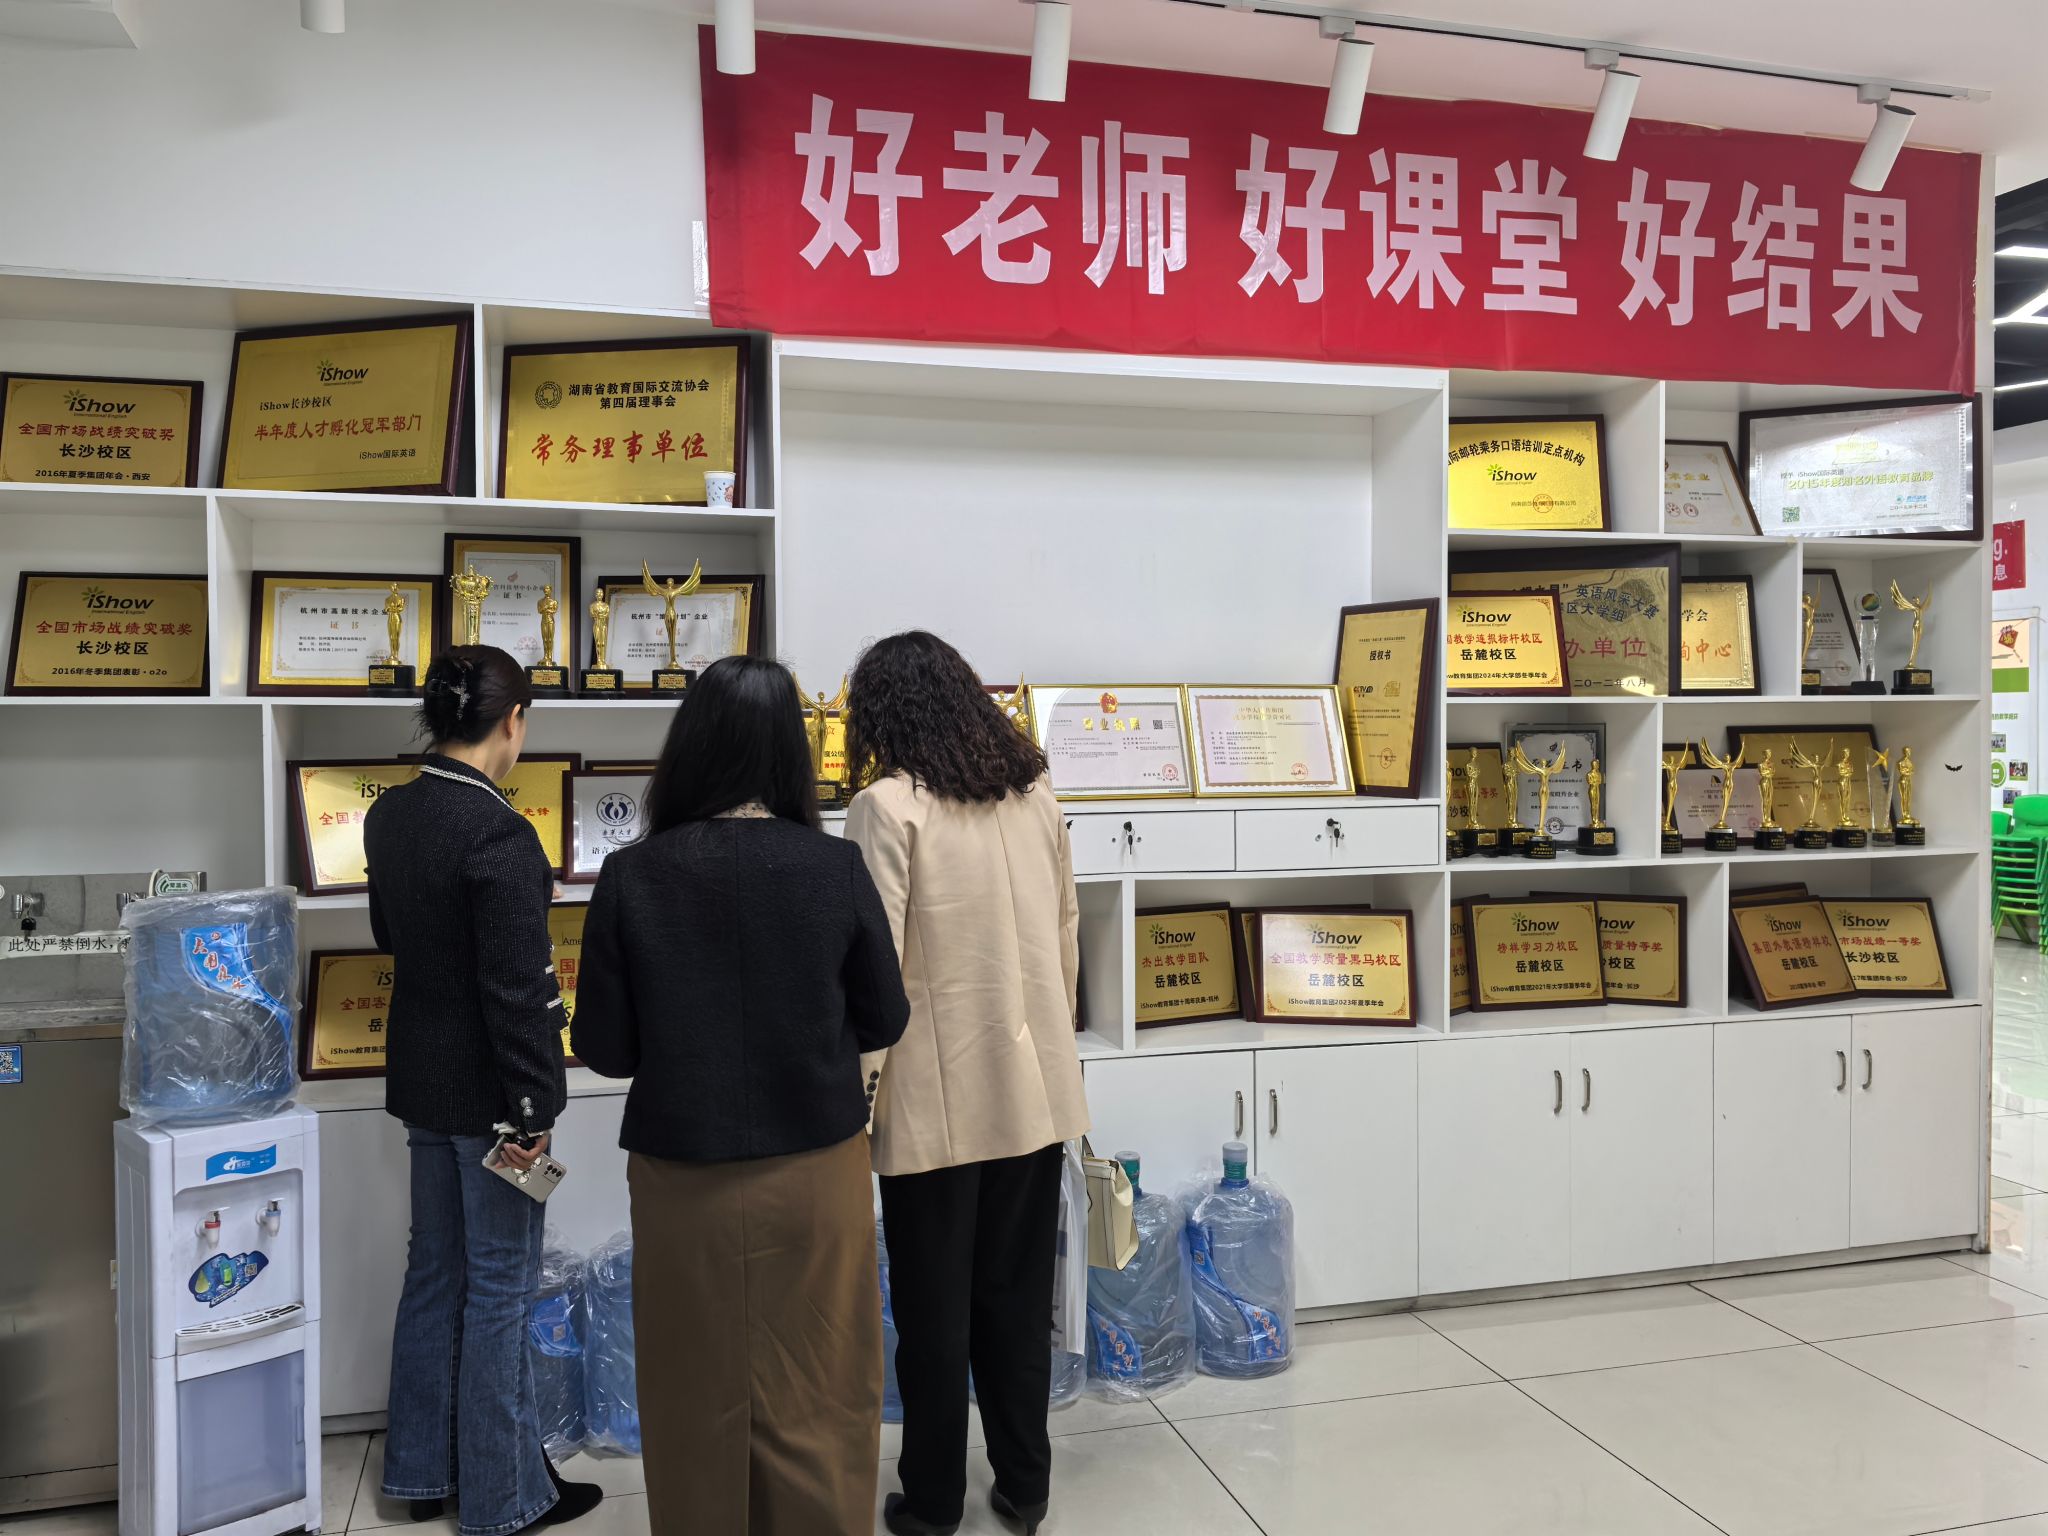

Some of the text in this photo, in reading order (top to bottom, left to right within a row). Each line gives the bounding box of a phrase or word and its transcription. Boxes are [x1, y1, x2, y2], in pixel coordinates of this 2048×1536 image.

[794, 94, 1922, 338] 好老师 好课堂 好结果
[320, 365, 369, 381] iShow
[569, 379, 709, 396] 湖南省教育国际交流协会
[68, 396, 136, 414] iShow
[260, 395, 332, 411] iShow长沙校区
[600, 395, 676, 409] 第四届理事会
[18, 423, 175, 441] 全国市场战绩突破奖
[255, 413, 422, 441] 半年度人才孵化冠军部门
[59, 444, 132, 460] 长沙校区
[359, 447, 416, 460] iShow国际英语
[531, 430, 709, 466] 常务理事单位
[1492, 470, 1537, 482] iShow
[1994, 539, 2008, 561] g.
[1994, 563, 2008, 581] 息
[87, 594, 154, 609] iShow
[1462, 611, 1512, 622] iShow
[1560, 602, 1626, 622] 区大学组
[36, 620, 193, 636] 全国市场战绩突破奖
[76, 640, 149, 656] 长沙校区
[1460, 648, 1516, 660] 岳麓校区
[1369, 650, 1391, 661] 授权书
[518, 807, 550, 817] 先锋
[1517, 919, 1560, 932] iShow
[1600, 917, 1635, 930] how
[1770, 919, 1802, 932] iShow
[1842, 915, 1890, 927] iShow
[1154, 931, 1196, 945] iShow
[1312, 930, 1363, 944] iShow
[1840, 936, 1922, 946] 市场战绩一等奖
[1601, 940, 1663, 952] 质量特等奖
[1142, 951, 1209, 968] 杰出教学团队
[1270, 952, 1402, 966] 全国教学质量黑马校区
[1781, 956, 1819, 971] 岳麓校区
[1845, 952, 1900, 964] 长沙校区
[1516, 960, 1564, 973] 岳麓校区
[1154, 972, 1202, 989] 岳麓校区
[1308, 974, 1364, 987] 岳麓校区
[1851, 974, 1908, 982] 17年集团年会·长沙
[341, 997, 388, 1011] 全国客
[368, 1017, 386, 1033] 岳
